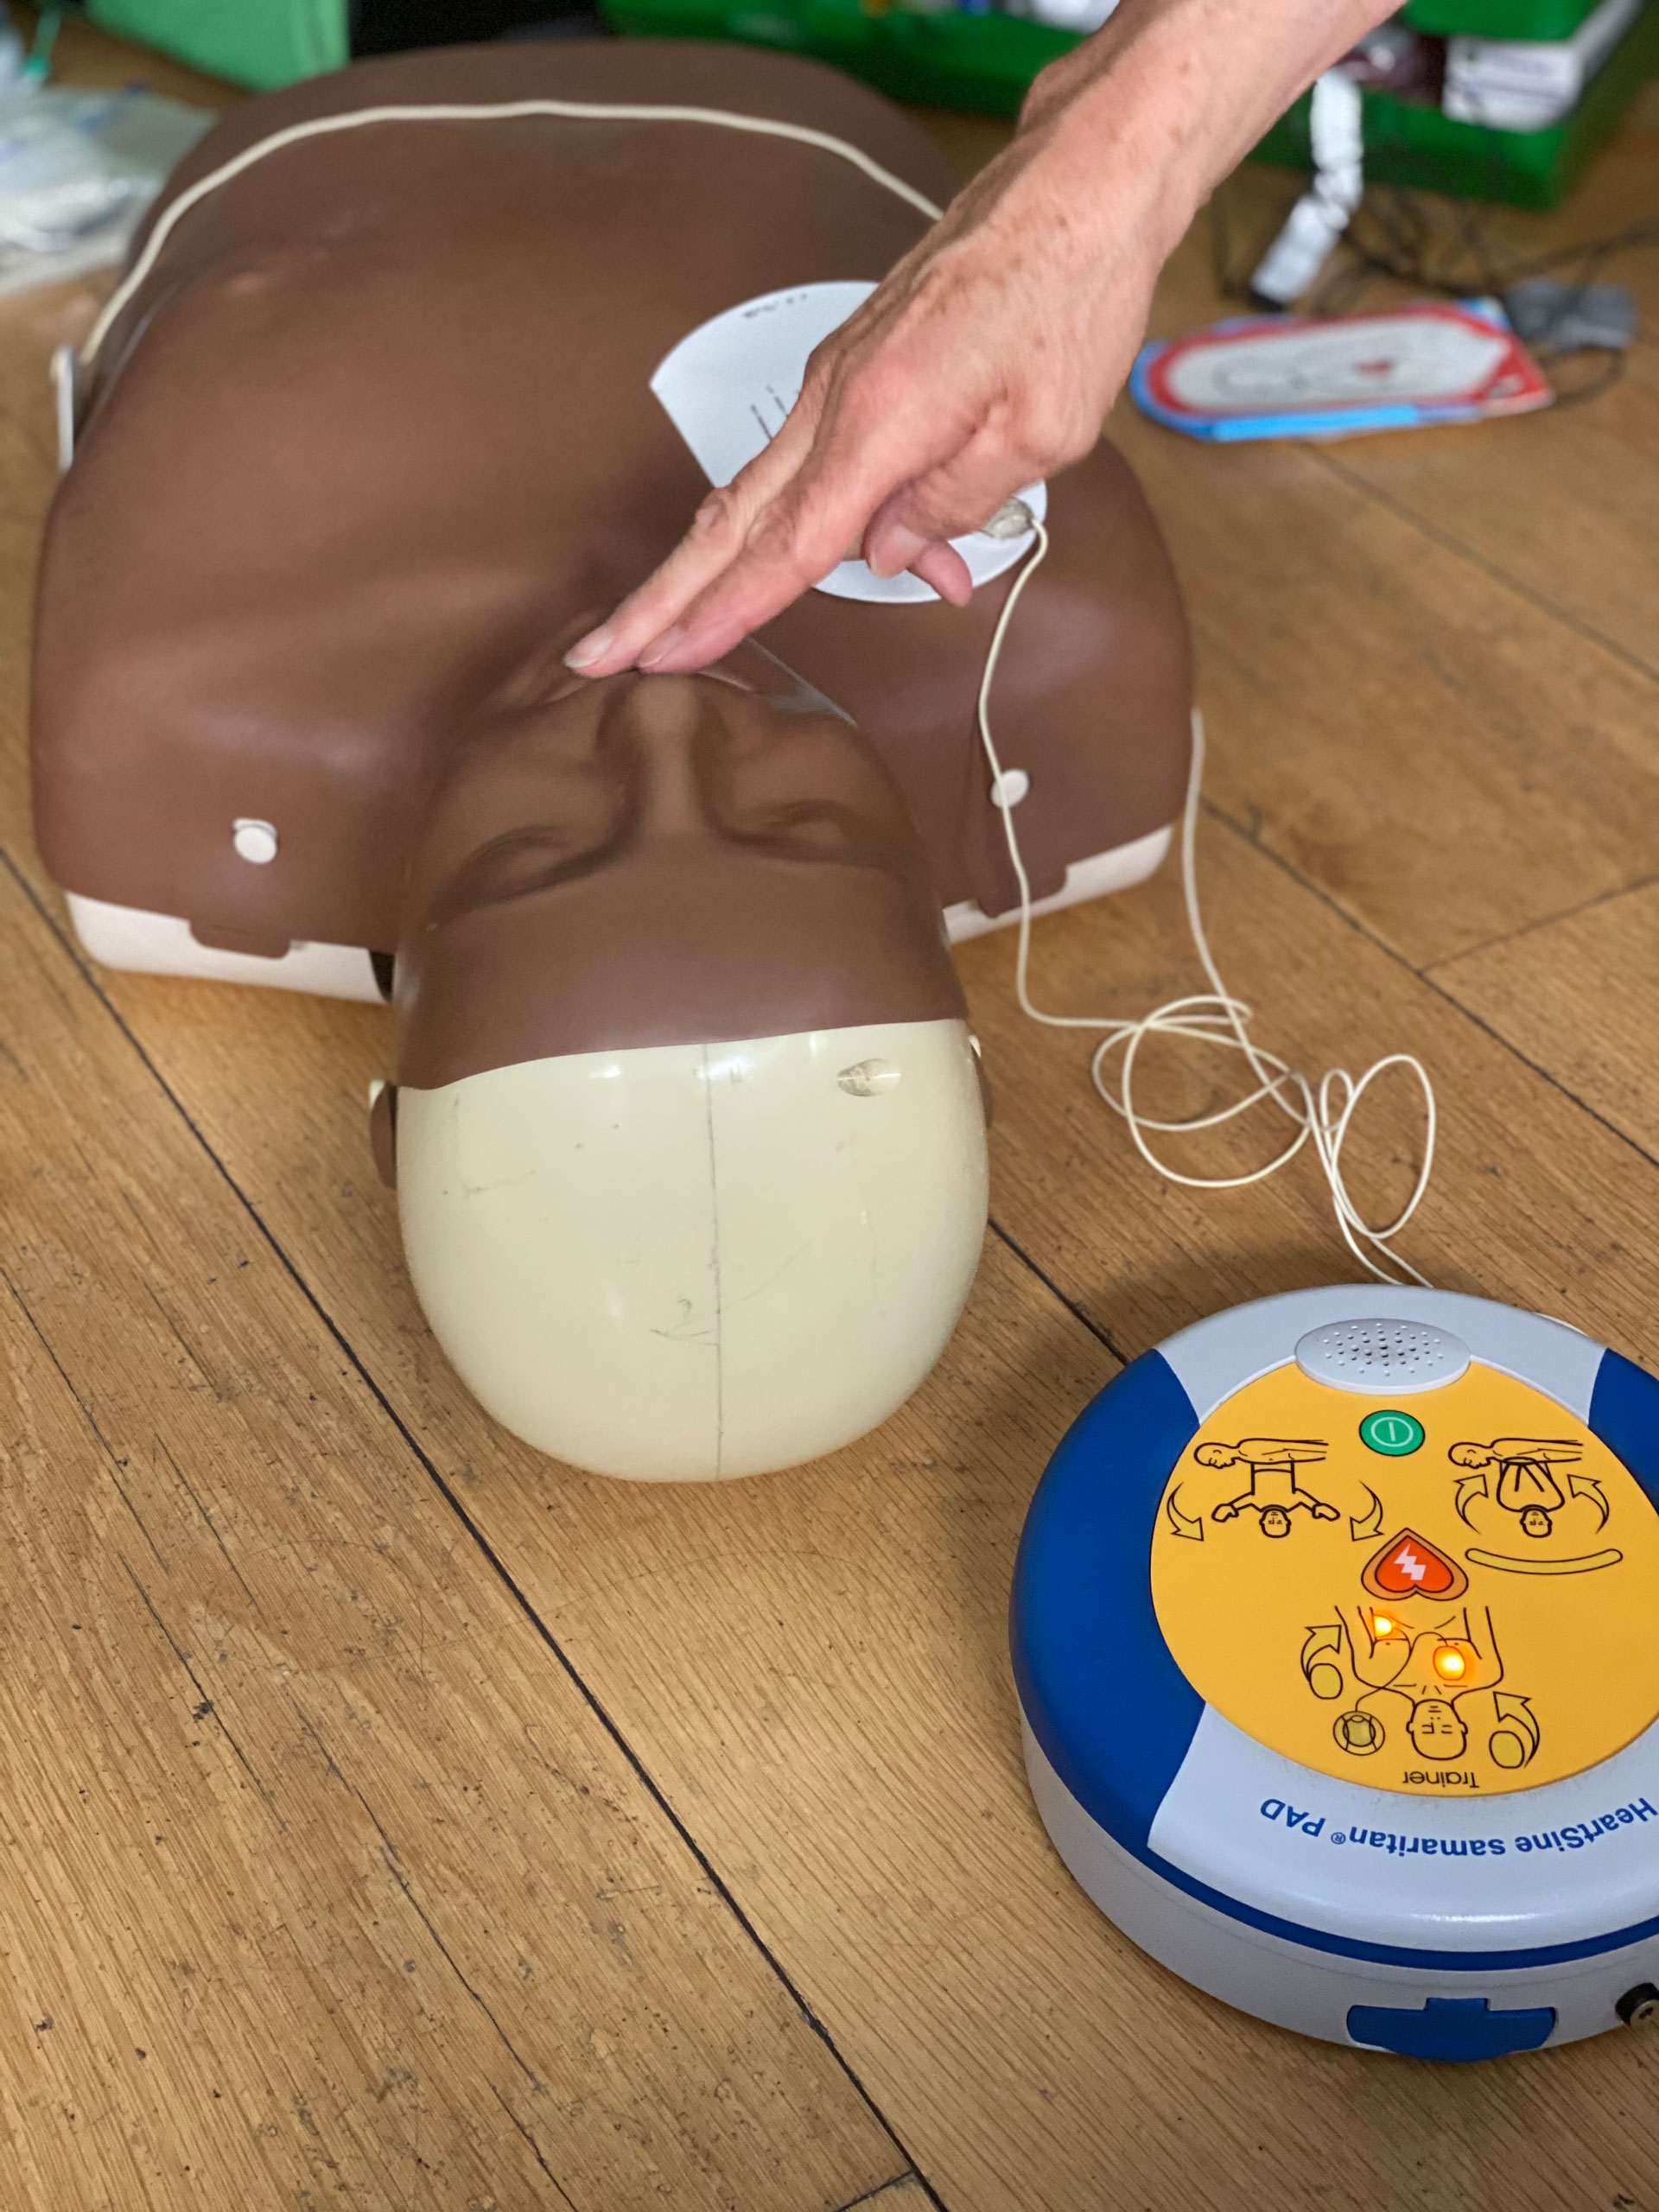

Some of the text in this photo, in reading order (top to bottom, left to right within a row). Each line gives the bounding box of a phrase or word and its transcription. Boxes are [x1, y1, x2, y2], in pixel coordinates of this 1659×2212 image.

[1402, 1770, 1480, 1789] Trainer
[1260, 1798, 1326, 1838] PAD
[1514, 1797, 1658, 1853] HeartSine
